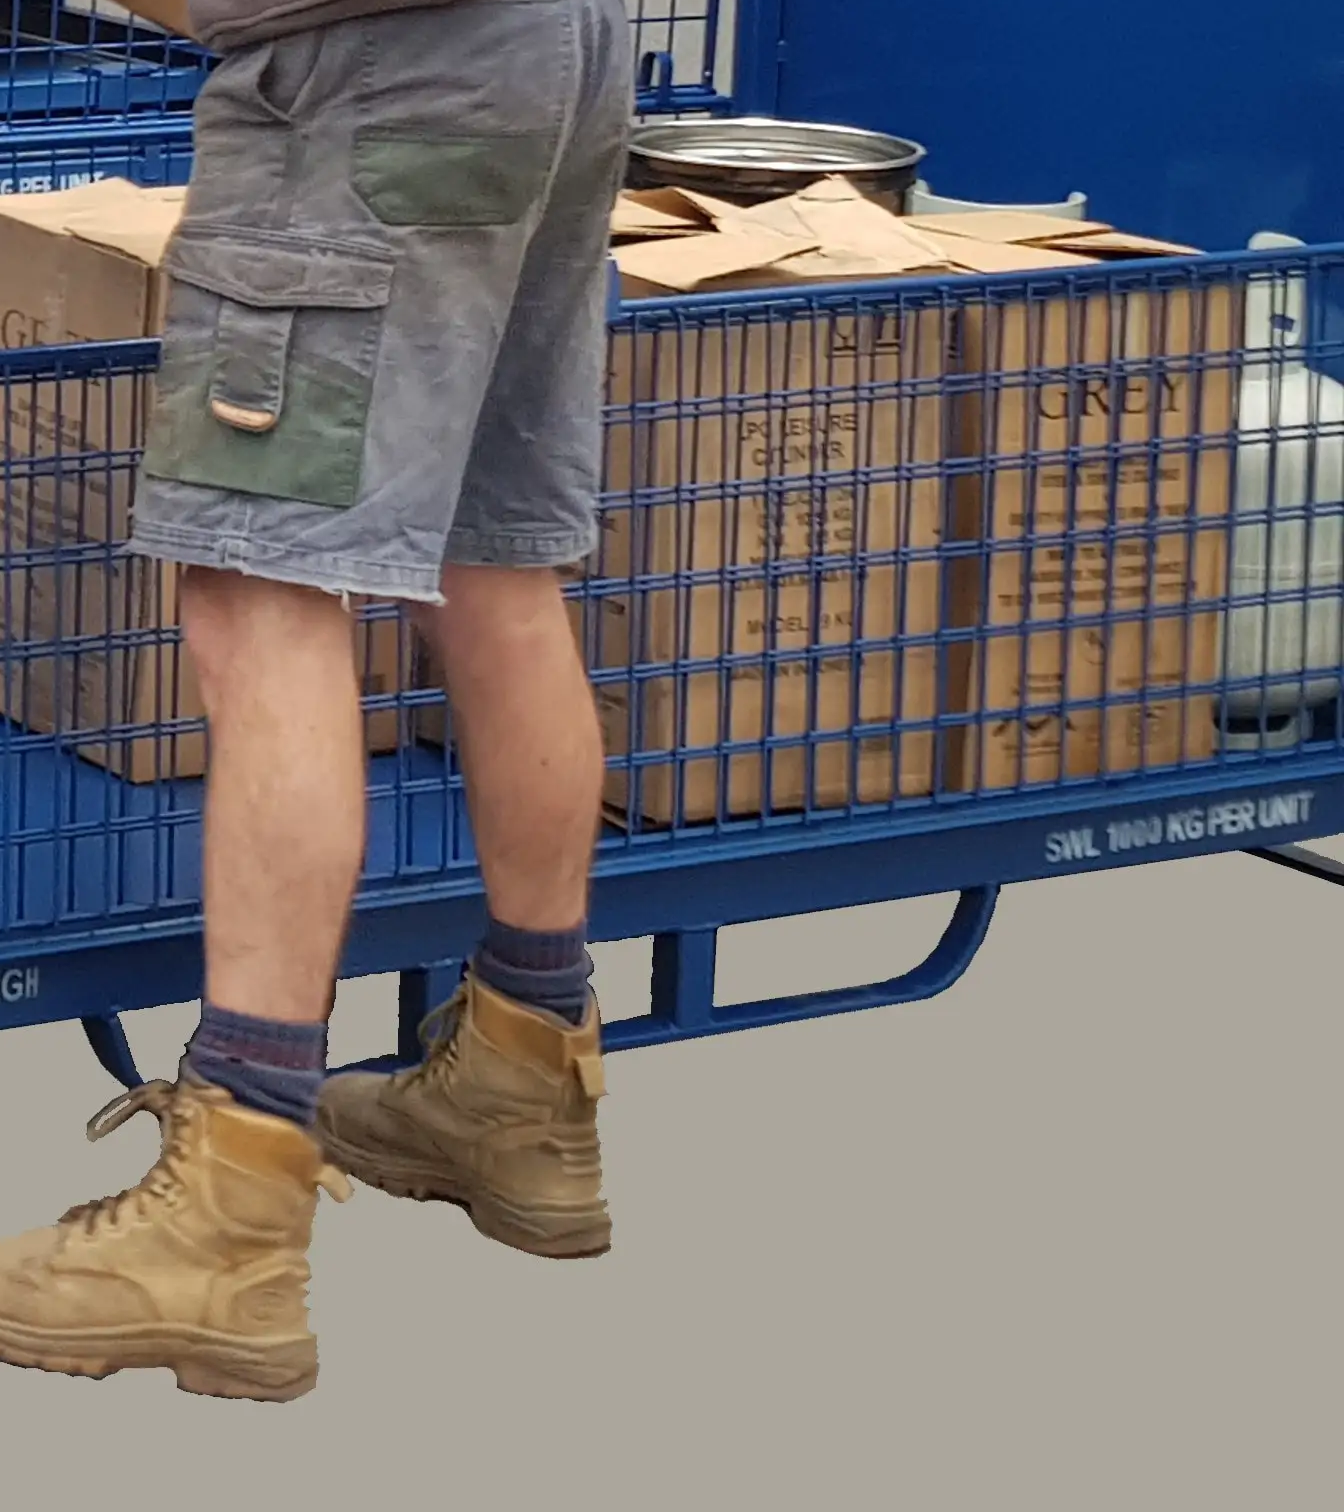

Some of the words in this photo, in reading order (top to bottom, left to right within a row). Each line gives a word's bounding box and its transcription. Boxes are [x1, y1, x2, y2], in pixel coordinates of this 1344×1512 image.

[1044, 827, 1101, 863] SWL
[1166, 805, 1204, 843] KG
[1207, 799, 1256, 837] PER
[1258, 790, 1315, 828] UNIT
